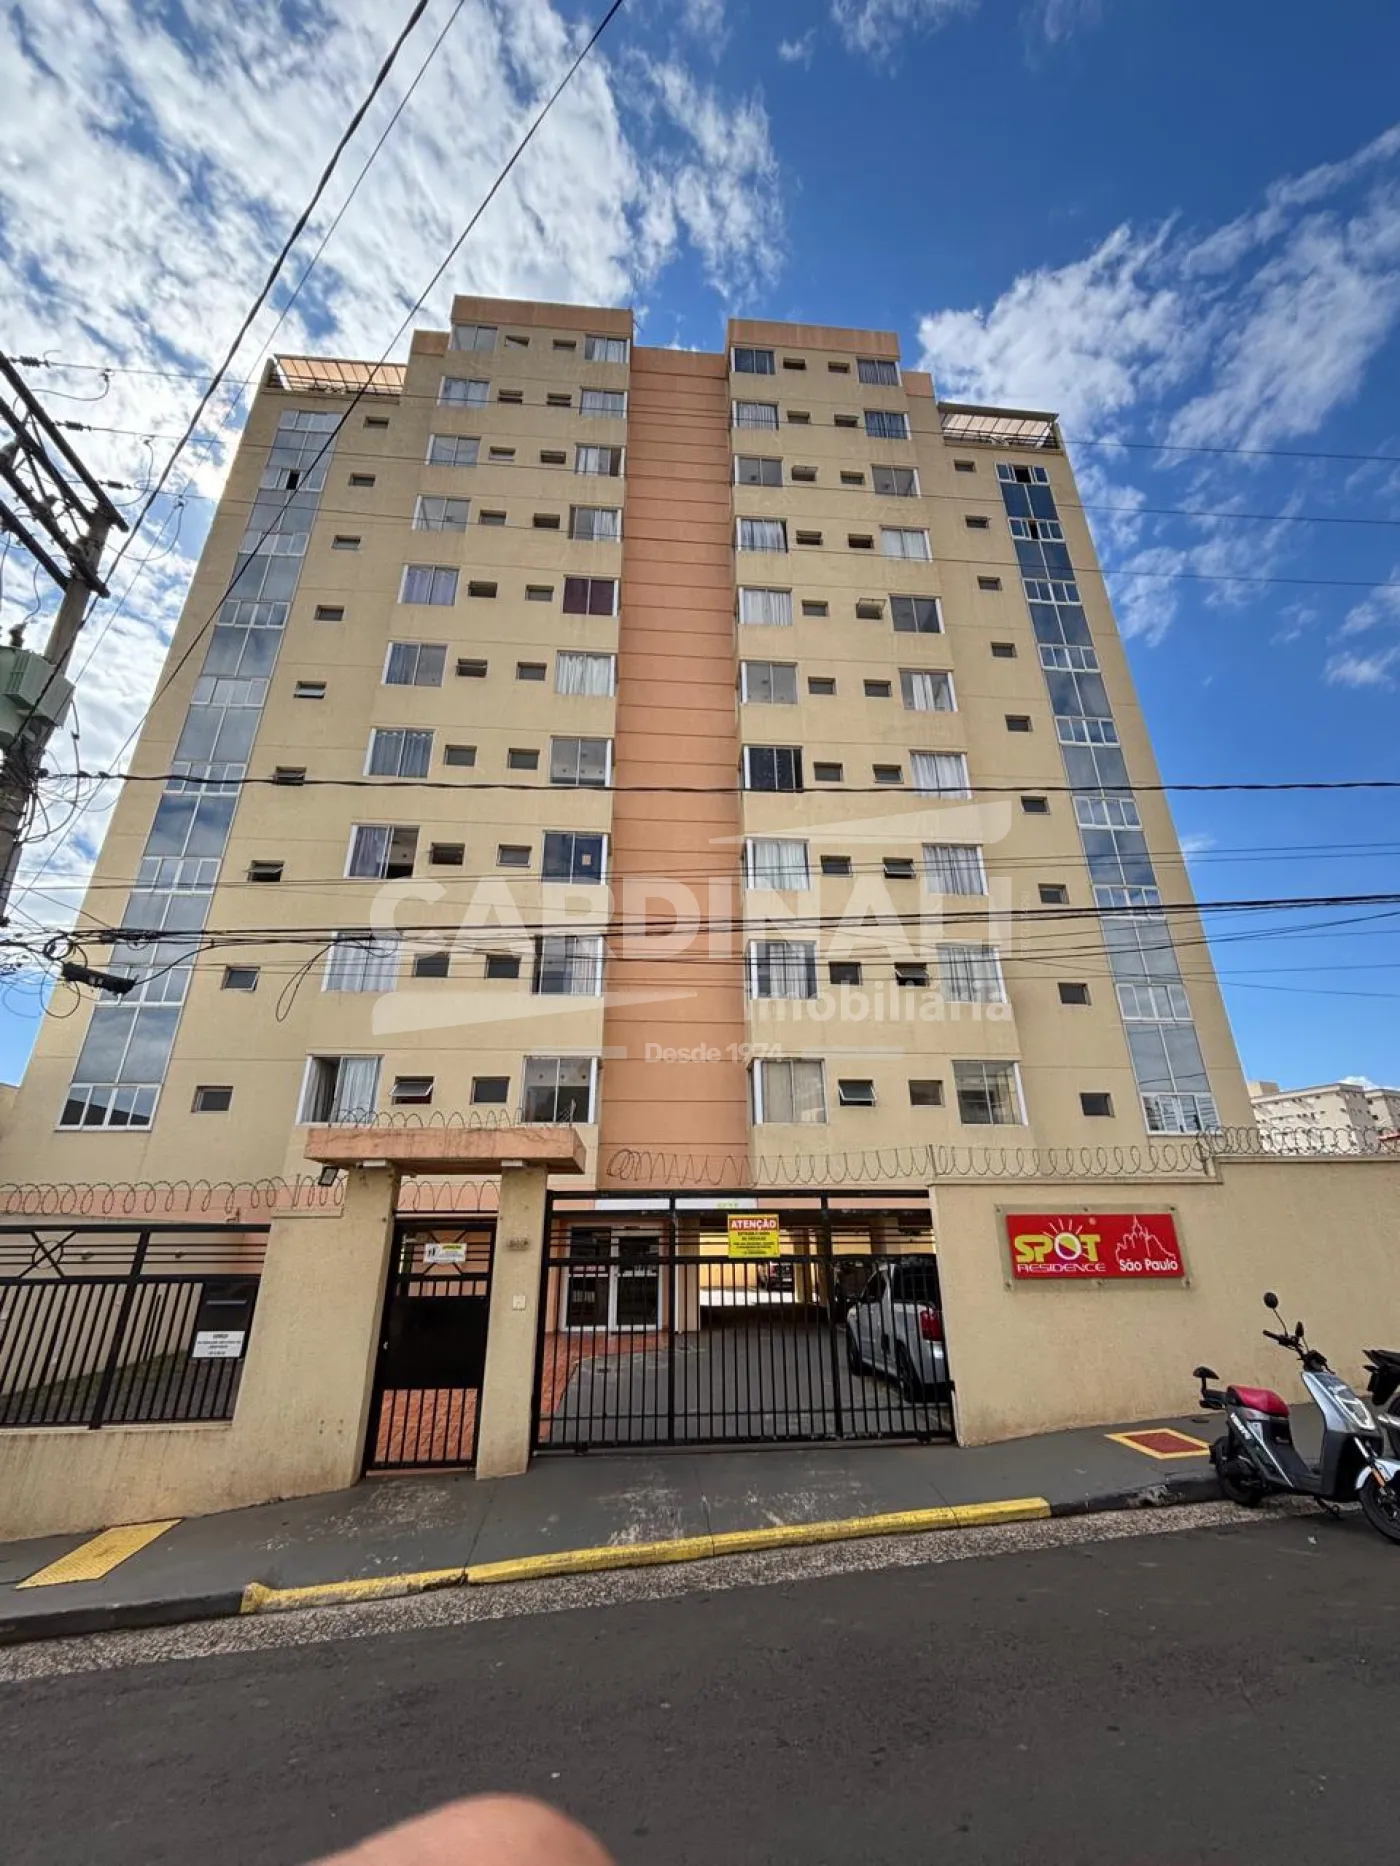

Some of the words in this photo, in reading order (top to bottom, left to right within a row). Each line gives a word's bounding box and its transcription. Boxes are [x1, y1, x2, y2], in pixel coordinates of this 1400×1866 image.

[731, 1218, 776, 1230] ATENÇÃO
[1014, 1231, 1101, 1263] SPOT
[1017, 1263, 1106, 1272] RESIDENCE
[1119, 1258, 1142, 1271] São
[1144, 1258, 1178, 1271] Paulo
